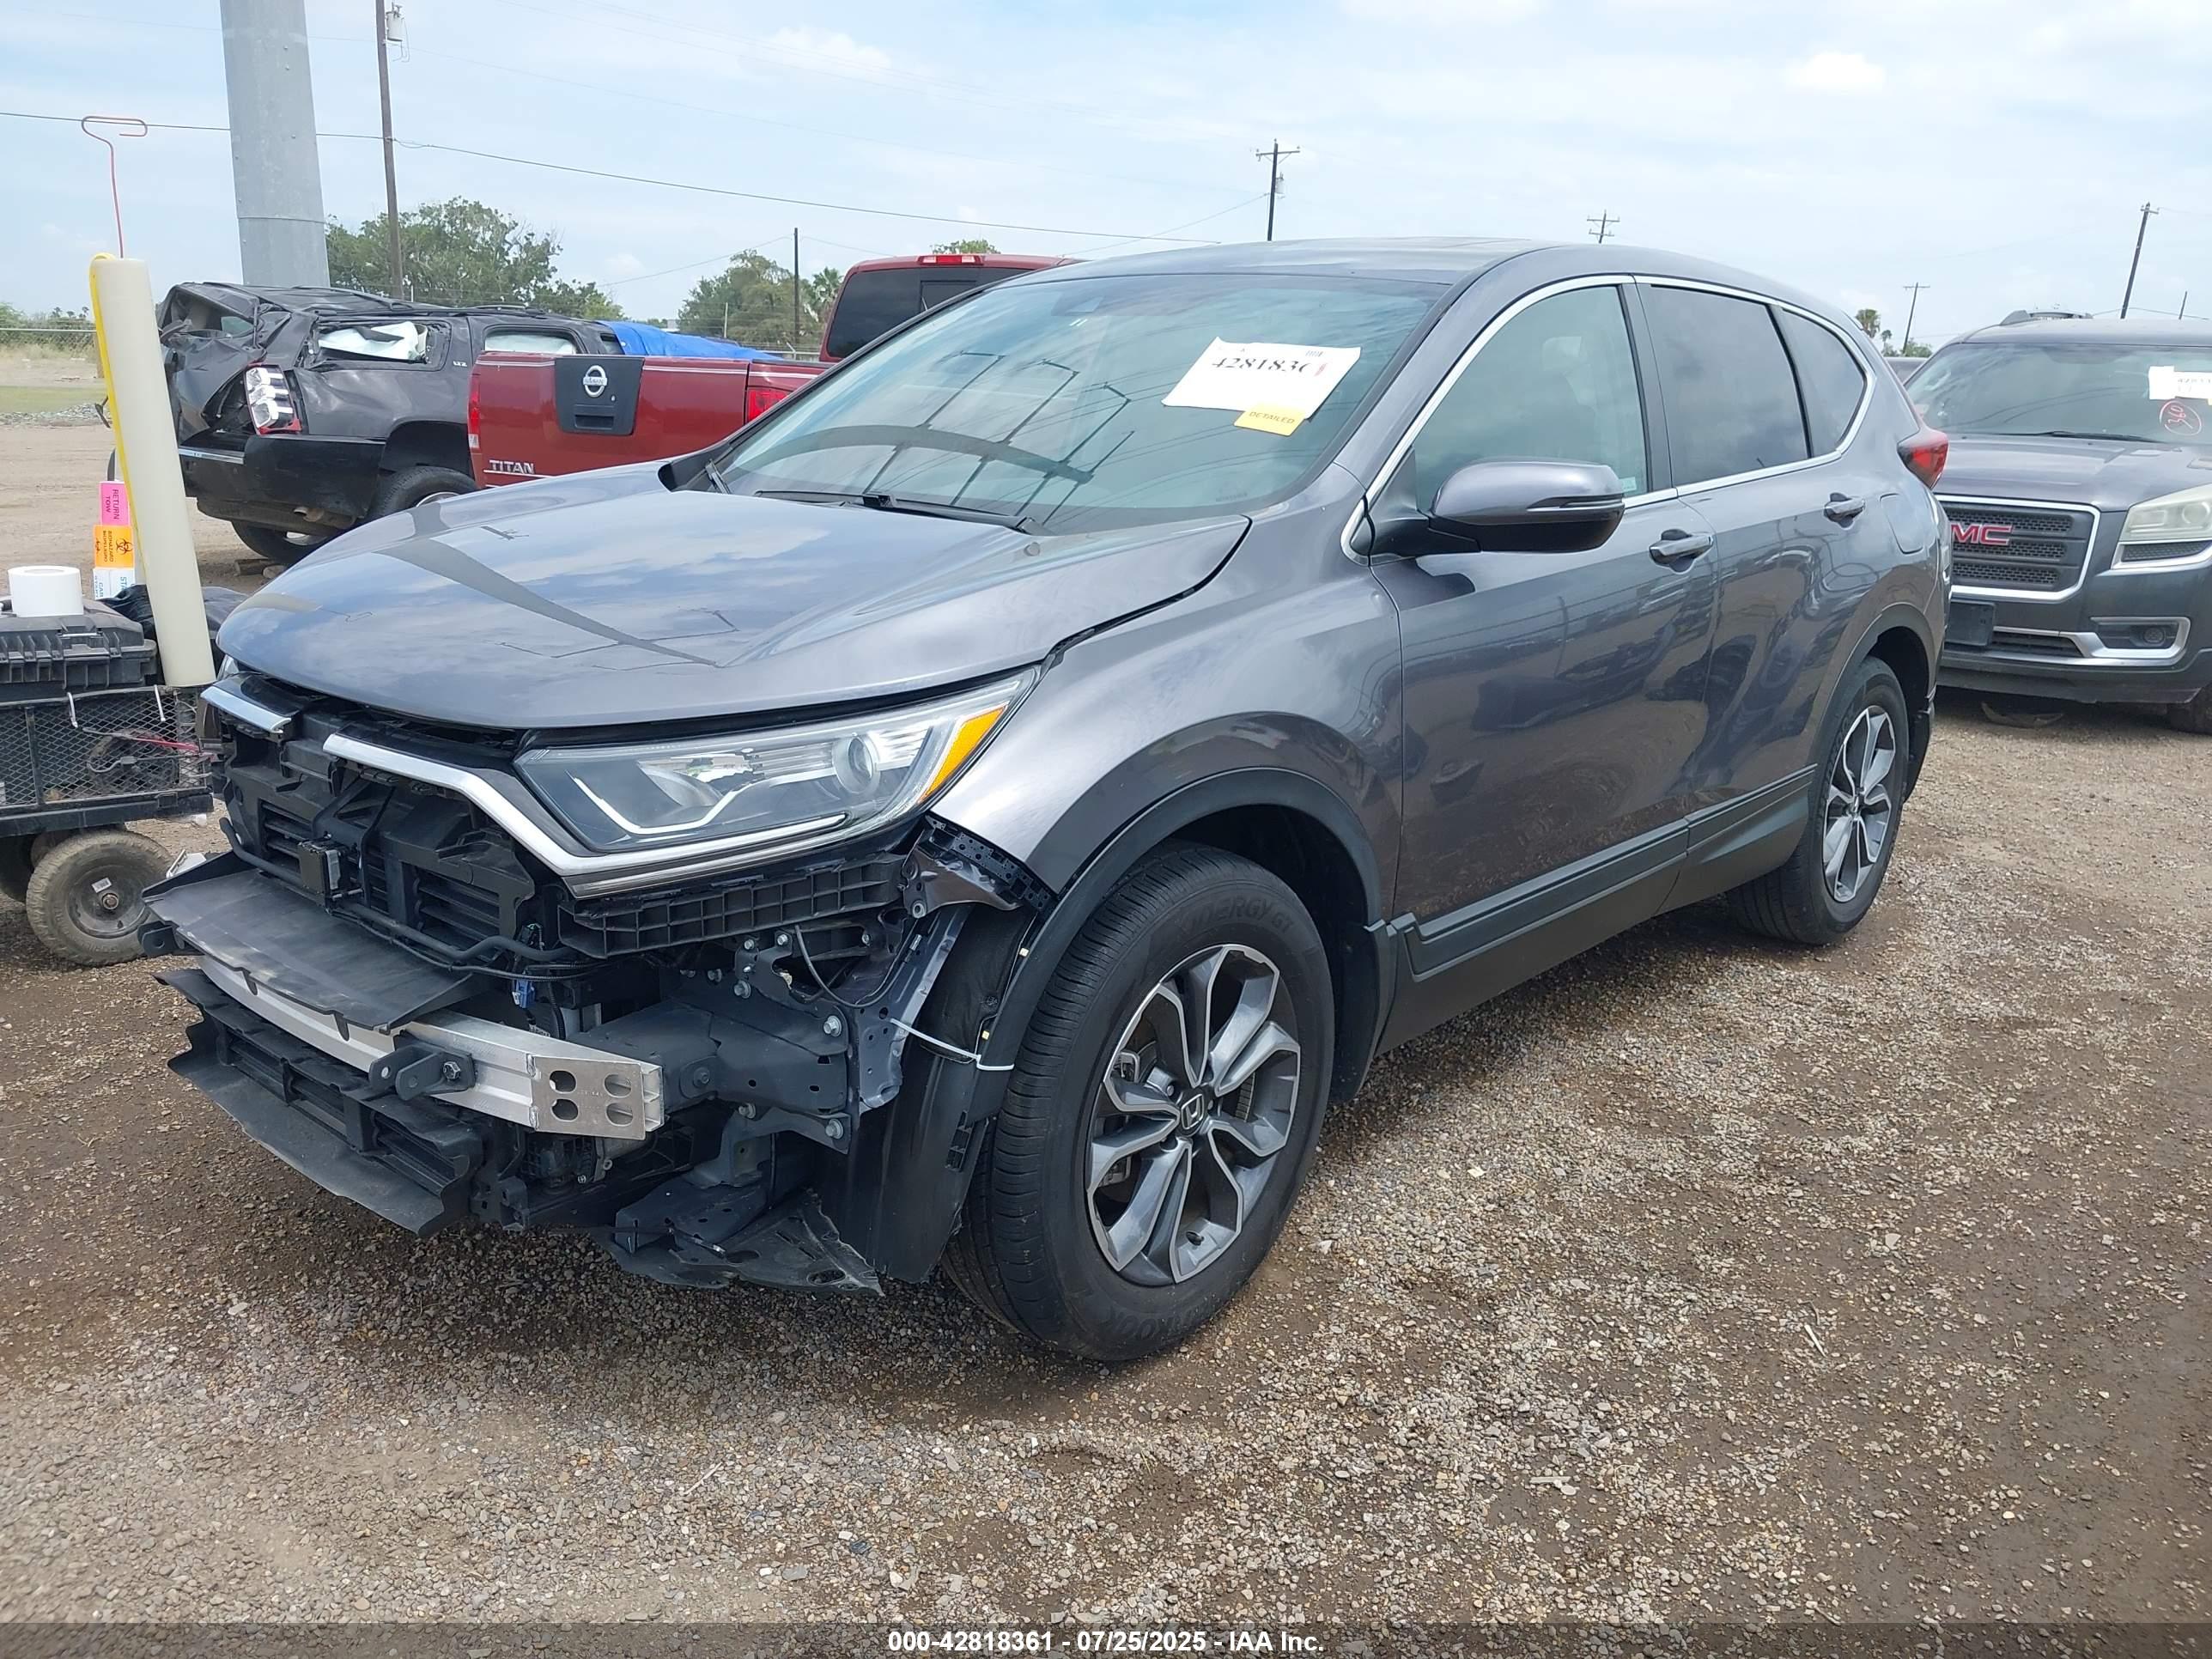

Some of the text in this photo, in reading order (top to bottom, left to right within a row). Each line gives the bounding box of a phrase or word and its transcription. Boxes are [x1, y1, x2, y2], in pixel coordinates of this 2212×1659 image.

[1248, 410, 1295, 425] DETAILED
[489, 459, 535, 475] TITAN
[112, 489, 120, 520] RETURN
[1950, 522, 2014, 546] MC
